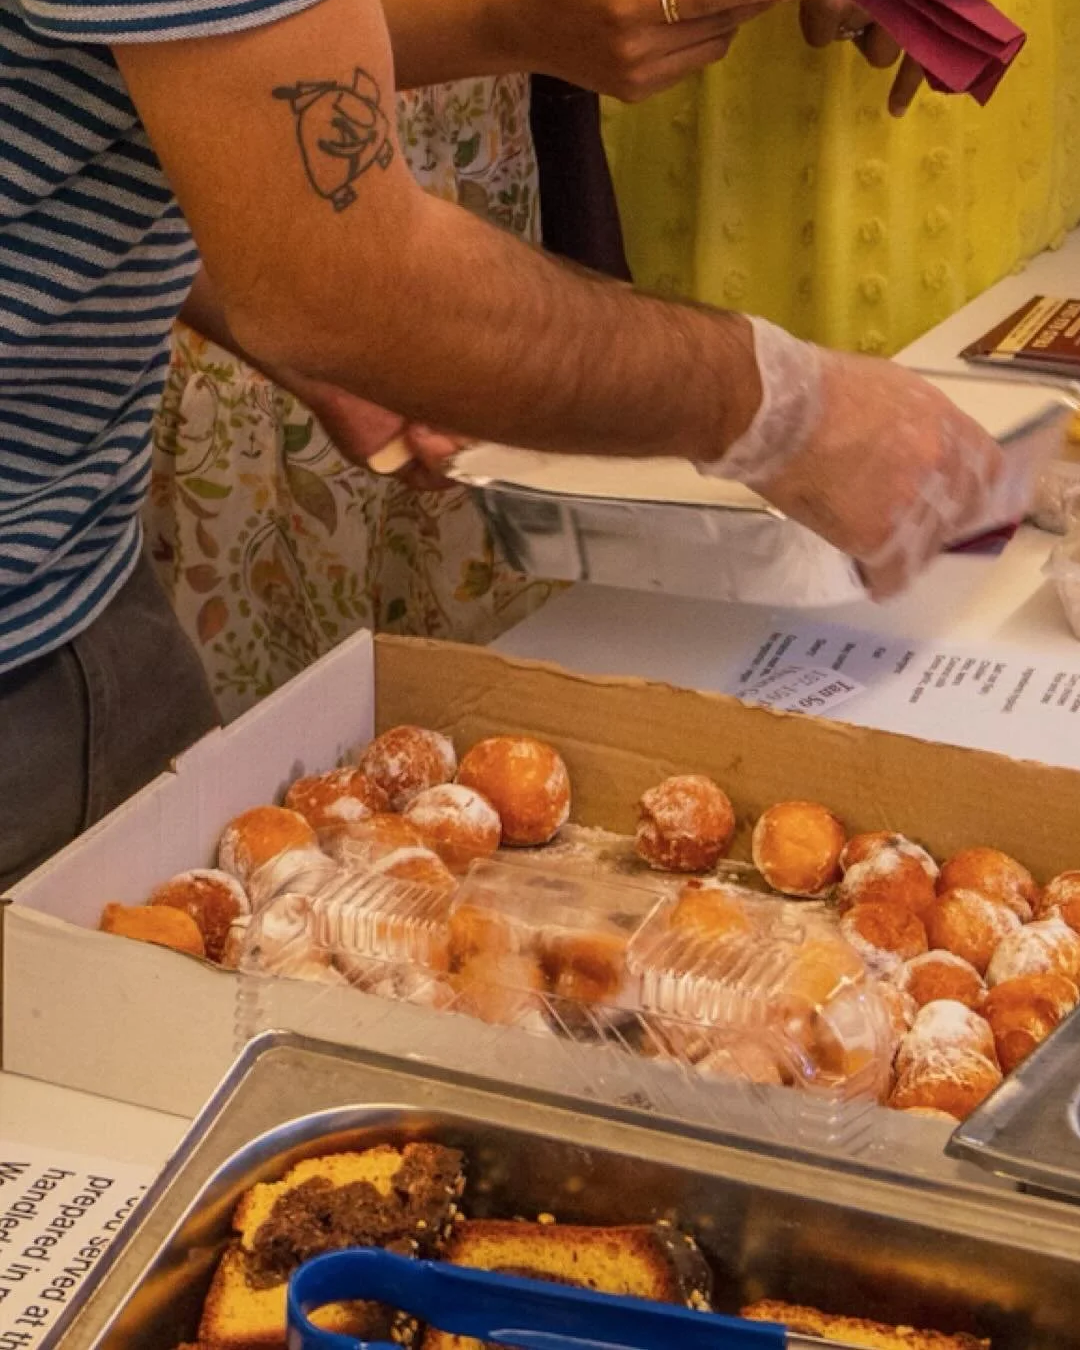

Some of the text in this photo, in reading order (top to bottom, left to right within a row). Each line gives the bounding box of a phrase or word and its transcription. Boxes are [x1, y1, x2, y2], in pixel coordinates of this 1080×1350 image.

[0, 1173, 116, 1282] prepared in
[14, 1305, 50, 1328] at
